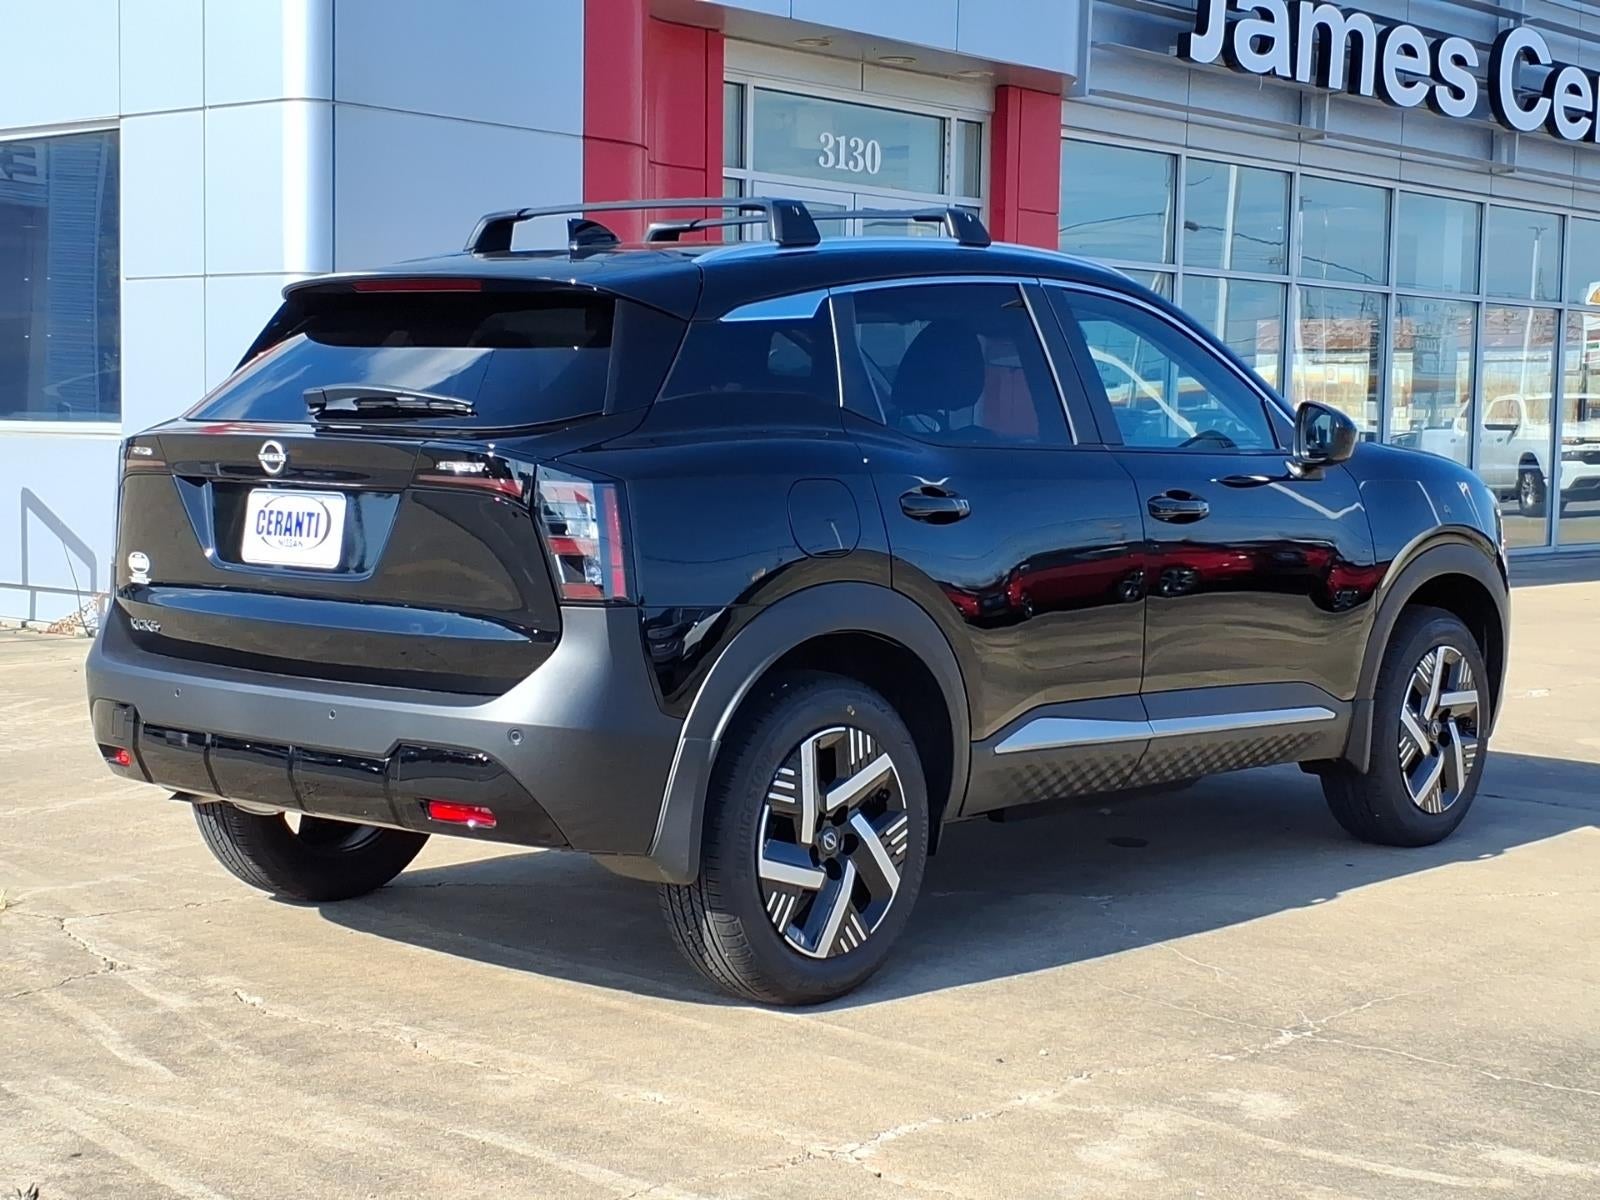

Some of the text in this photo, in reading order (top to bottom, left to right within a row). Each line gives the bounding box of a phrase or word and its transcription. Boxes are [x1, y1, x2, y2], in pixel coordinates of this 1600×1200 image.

[1499, 27, 1600, 142] Ce
[819, 132, 881, 174] 3130
[256, 509, 321, 538] CERANTI
